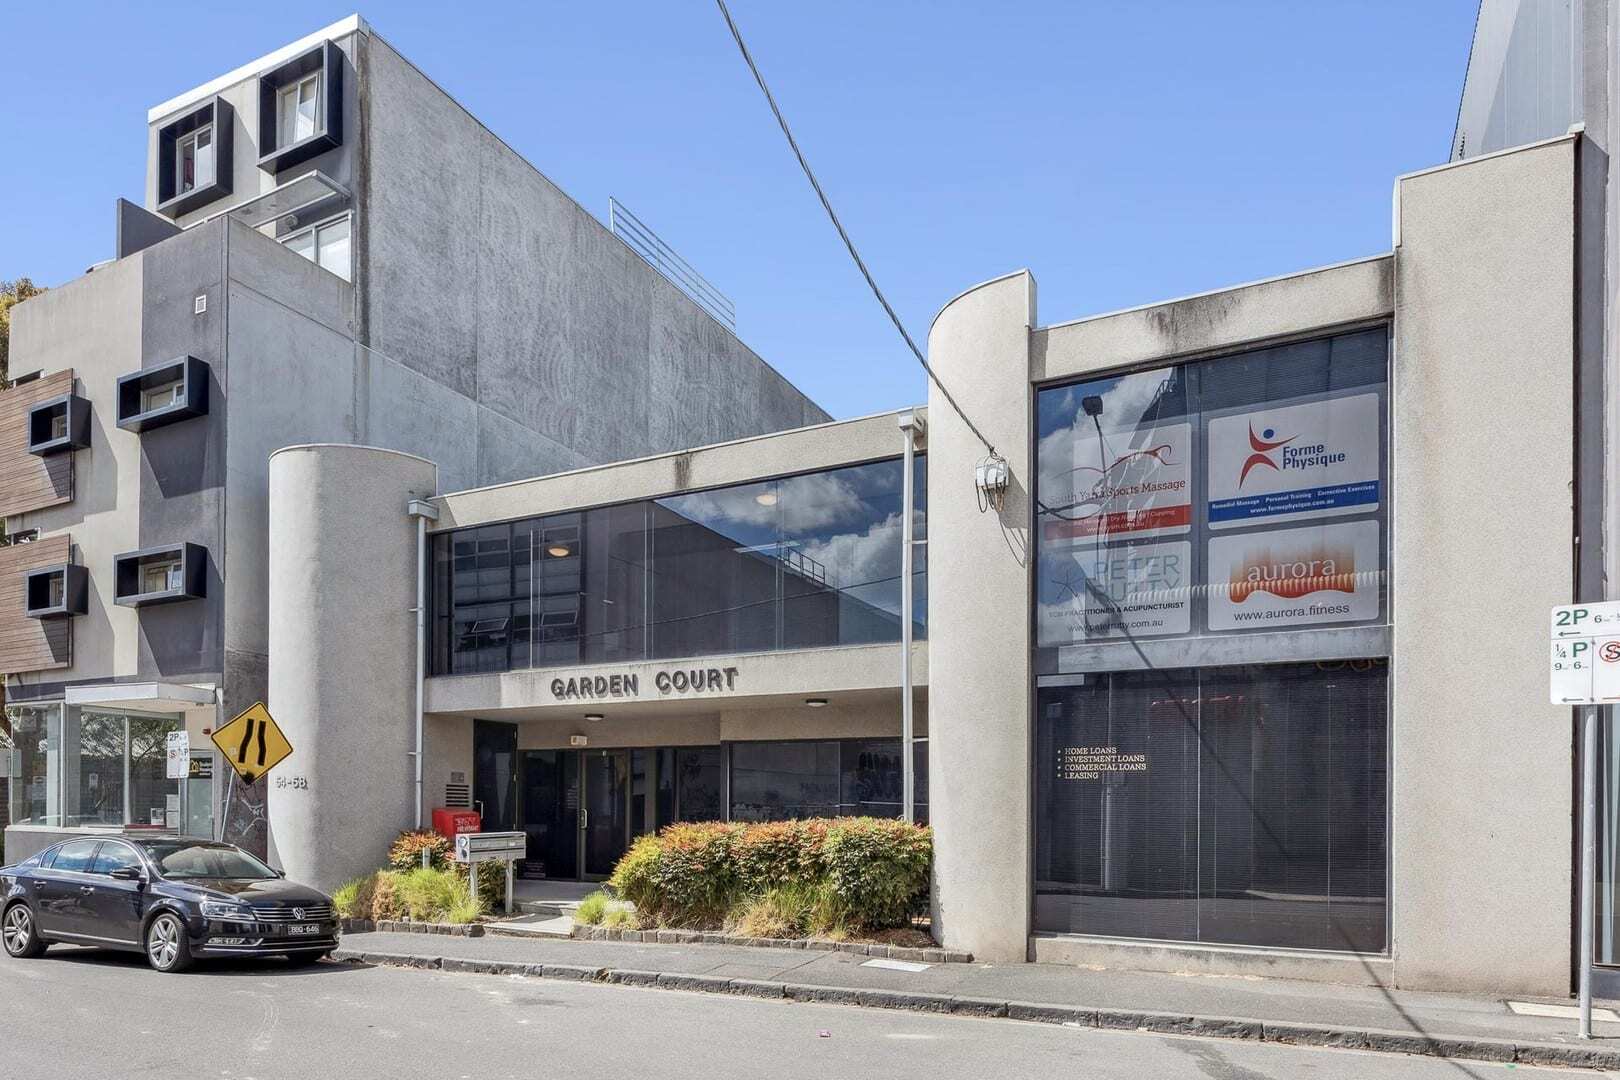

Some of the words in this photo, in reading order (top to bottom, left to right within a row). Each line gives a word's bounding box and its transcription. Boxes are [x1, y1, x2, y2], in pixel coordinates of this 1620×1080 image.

[1282, 444, 1324, 458] Forme
[1282, 452, 1346, 470] Physique
[1107, 485, 1140, 499] Sports
[1141, 480, 1186, 494] Massage
[1248, 559, 1336, 582] aurora
[1123, 601, 1185, 613] ACUPUNCTURIST
[1234, 604, 1350, 621] www.aurora.fitness
[1556, 608, 1588, 626] 2P
[551, 674, 639, 698] GARDEN
[655, 667, 739, 694] COURT
[1064, 747, 1089, 755] HOME
[1065, 755, 1117, 763] INVESTMENT
[1118, 754, 1145, 762] LOANS
[1064, 763, 1117, 771] COMMERCIAL
[1065, 772, 1099, 780] LEASING
